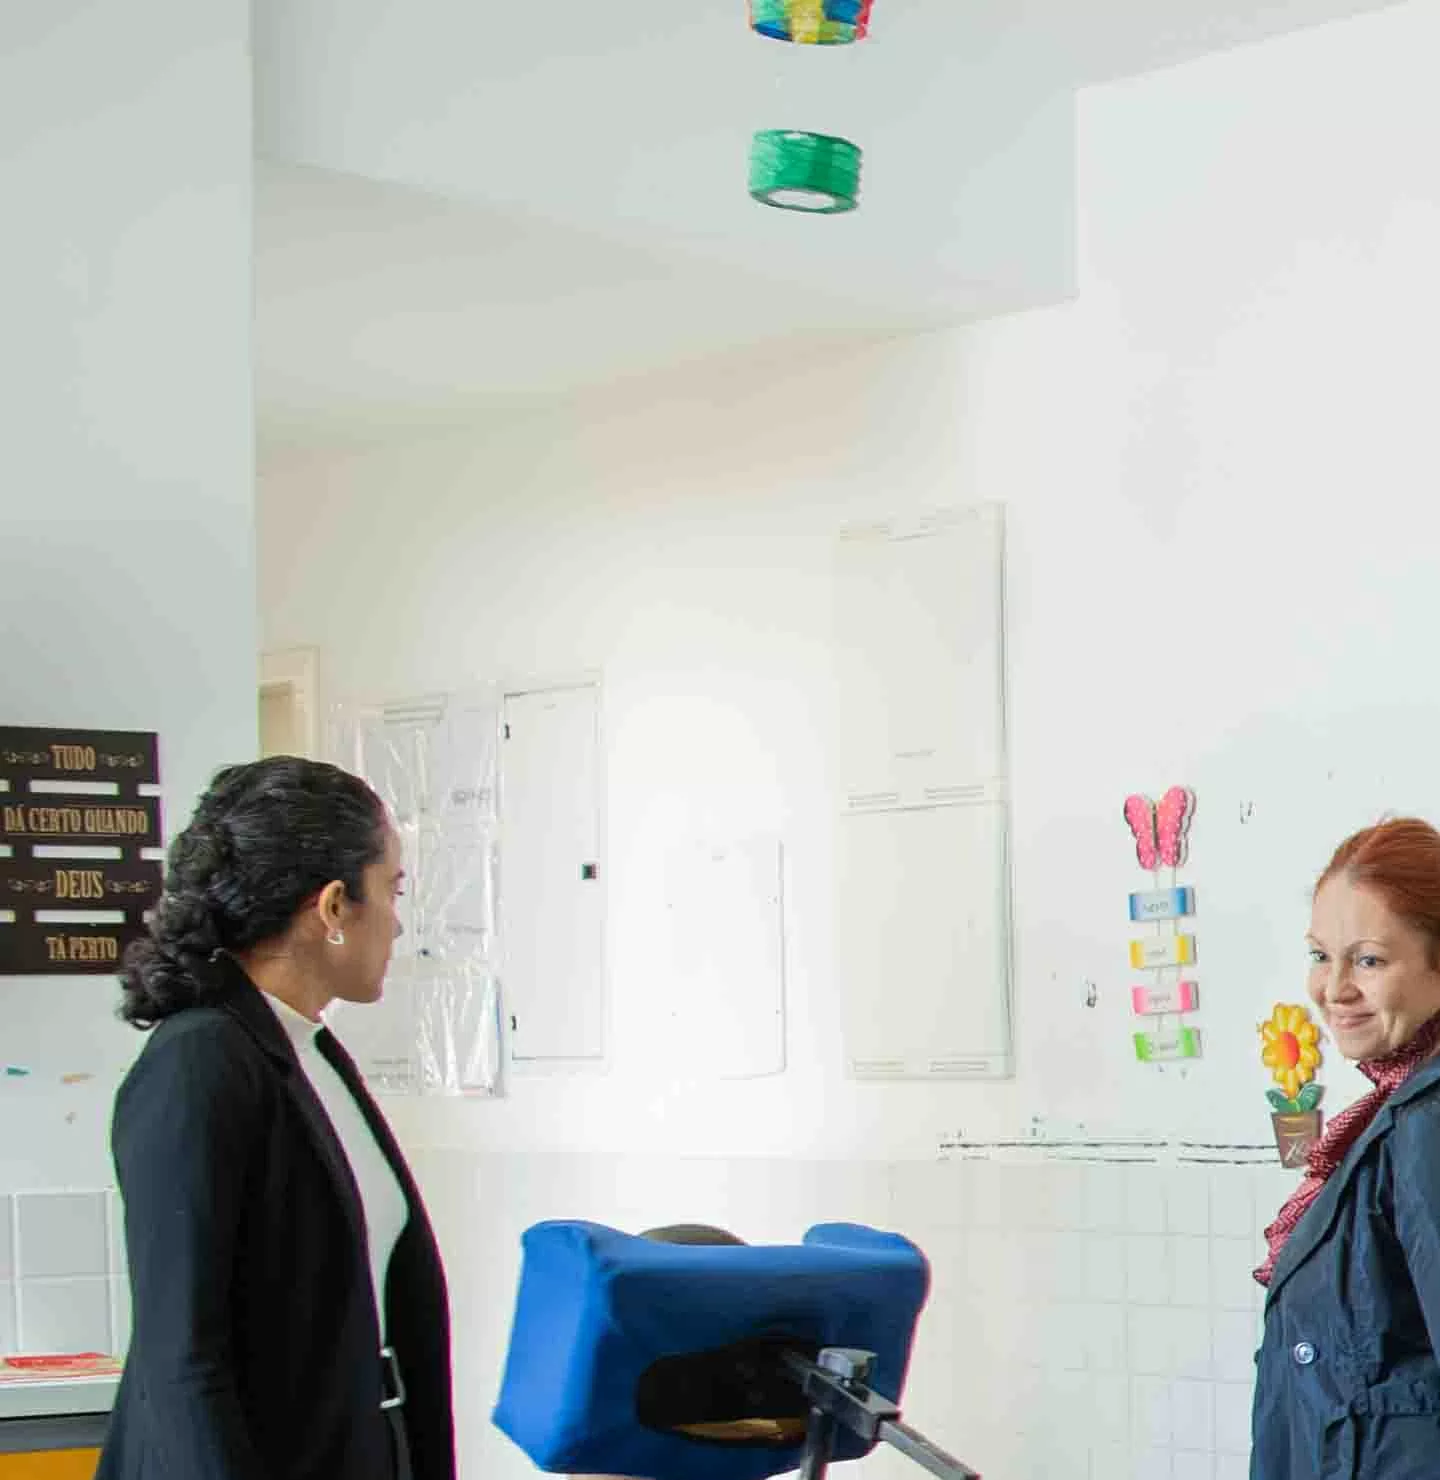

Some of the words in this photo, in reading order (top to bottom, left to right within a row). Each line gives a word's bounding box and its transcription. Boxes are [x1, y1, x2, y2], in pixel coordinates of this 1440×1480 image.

[51, 744, 97, 771] TUDO
[4, 803, 26, 833] DÁ
[28, 807, 82, 833] CERTO
[83, 807, 149, 834] QUANDO
[55, 869, 104, 898] DEUS
[46, 932, 66, 960] TÁ
[68, 935, 118, 961] PERTO
